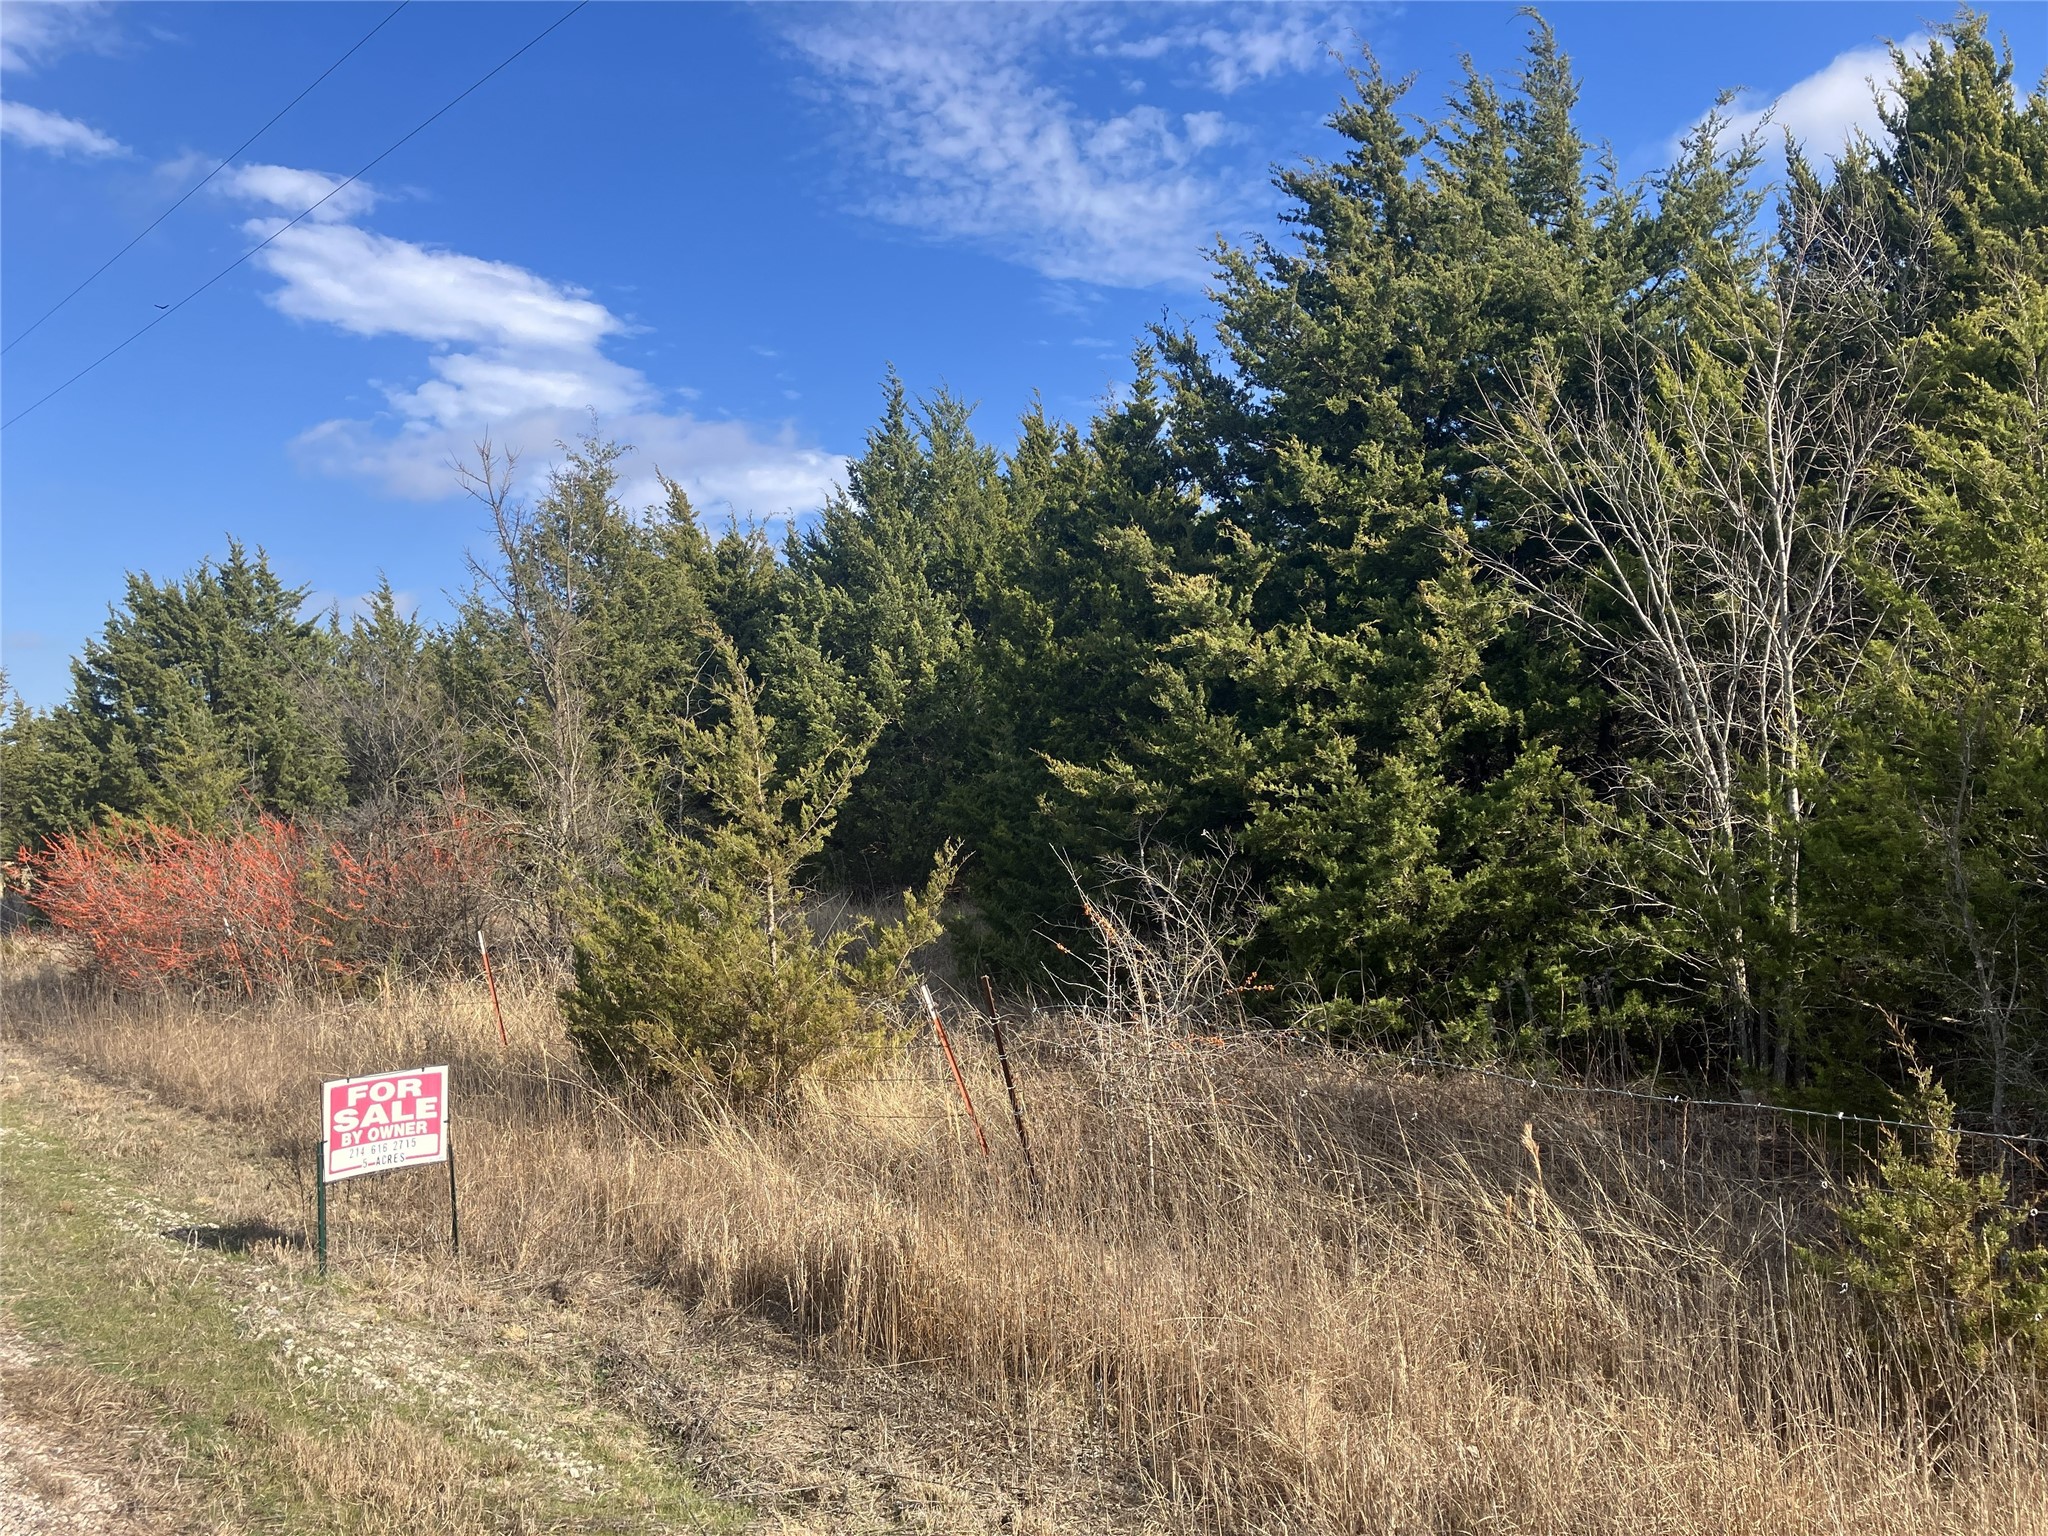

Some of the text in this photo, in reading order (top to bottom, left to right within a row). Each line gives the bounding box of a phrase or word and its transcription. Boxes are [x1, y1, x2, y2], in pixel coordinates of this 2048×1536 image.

[347, 1078, 422, 1107] FOR
[332, 1096, 438, 1133] SALE
[341, 1120, 428, 1147] BY OWNER
[349, 1138, 417, 1159] 214 616 2715
[362, 1153, 405, 1169] 5 ACRES
